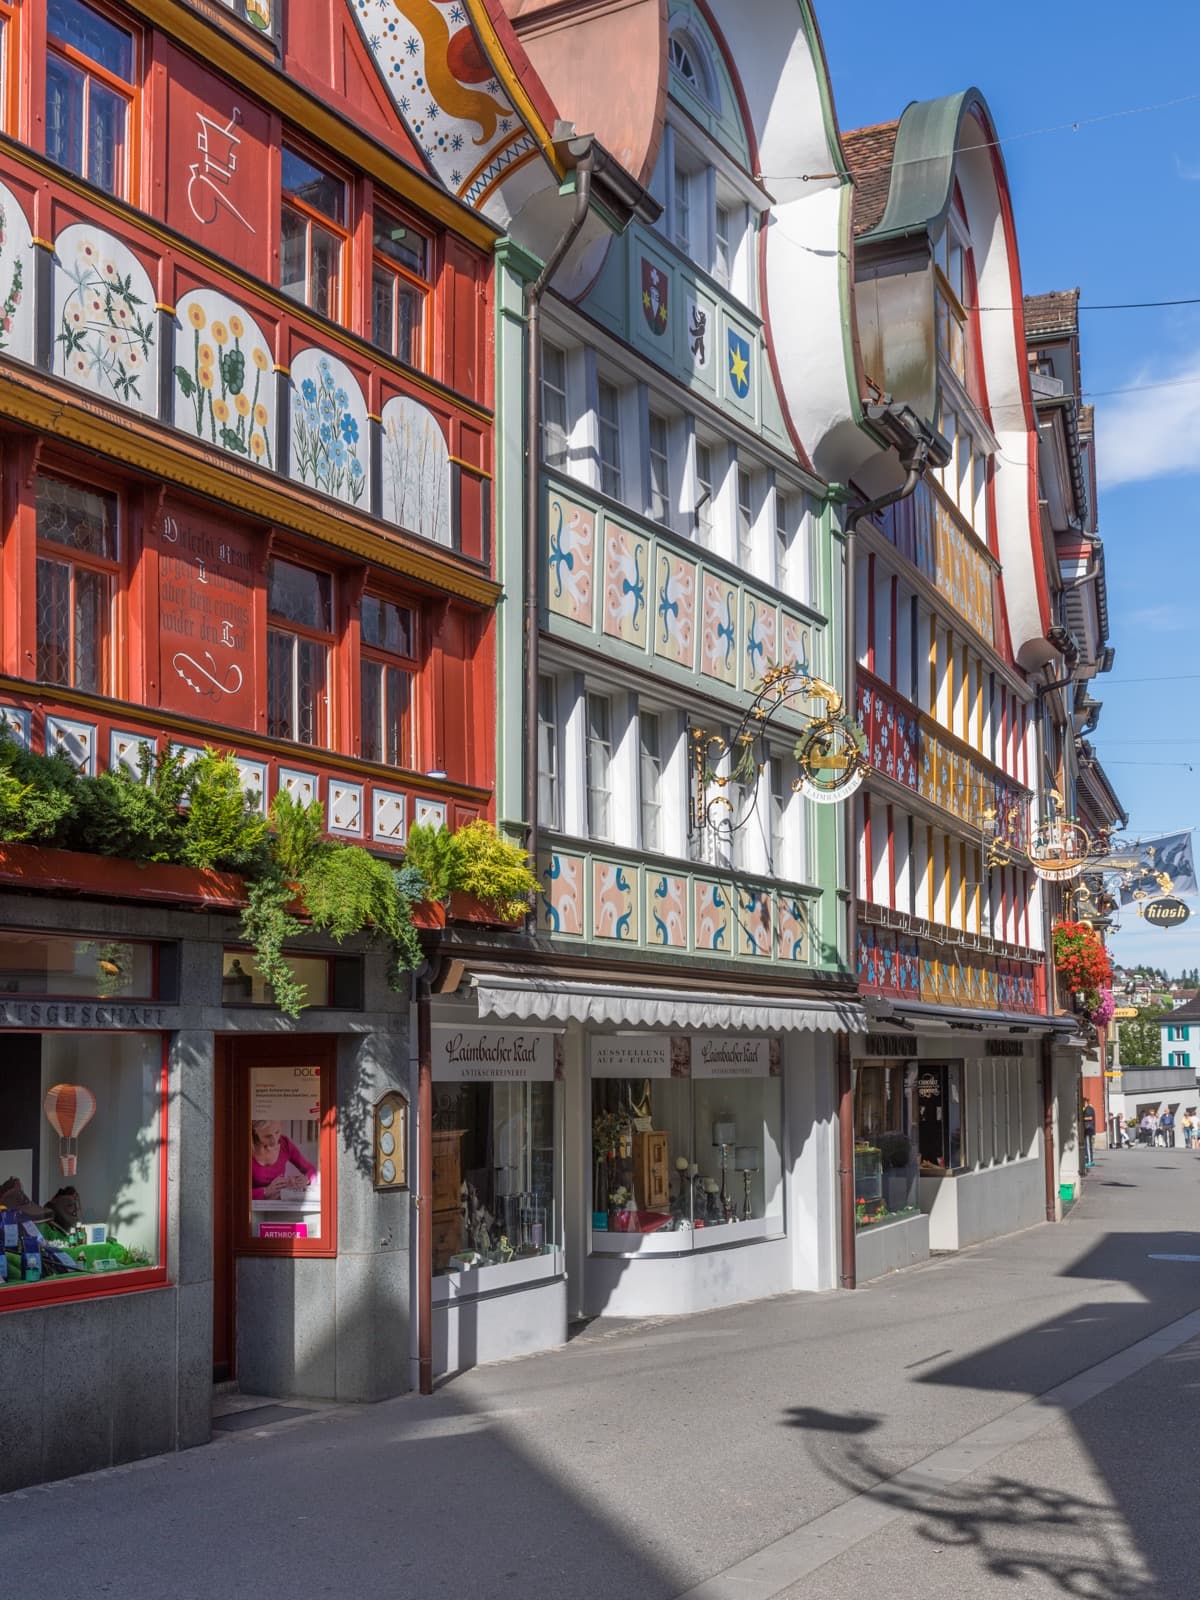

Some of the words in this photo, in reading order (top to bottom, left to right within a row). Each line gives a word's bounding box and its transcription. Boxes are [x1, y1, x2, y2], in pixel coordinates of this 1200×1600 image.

[445, 1033, 512, 1064] Laimbacher
[513, 1036, 540, 1063] Karl
[597, 1048, 666, 1057] AUSSTELLUNG
[461, 1069, 527, 1077] ANTIKSCHREINEREI
[264, 1231, 302, 1239] ARTHROSE
